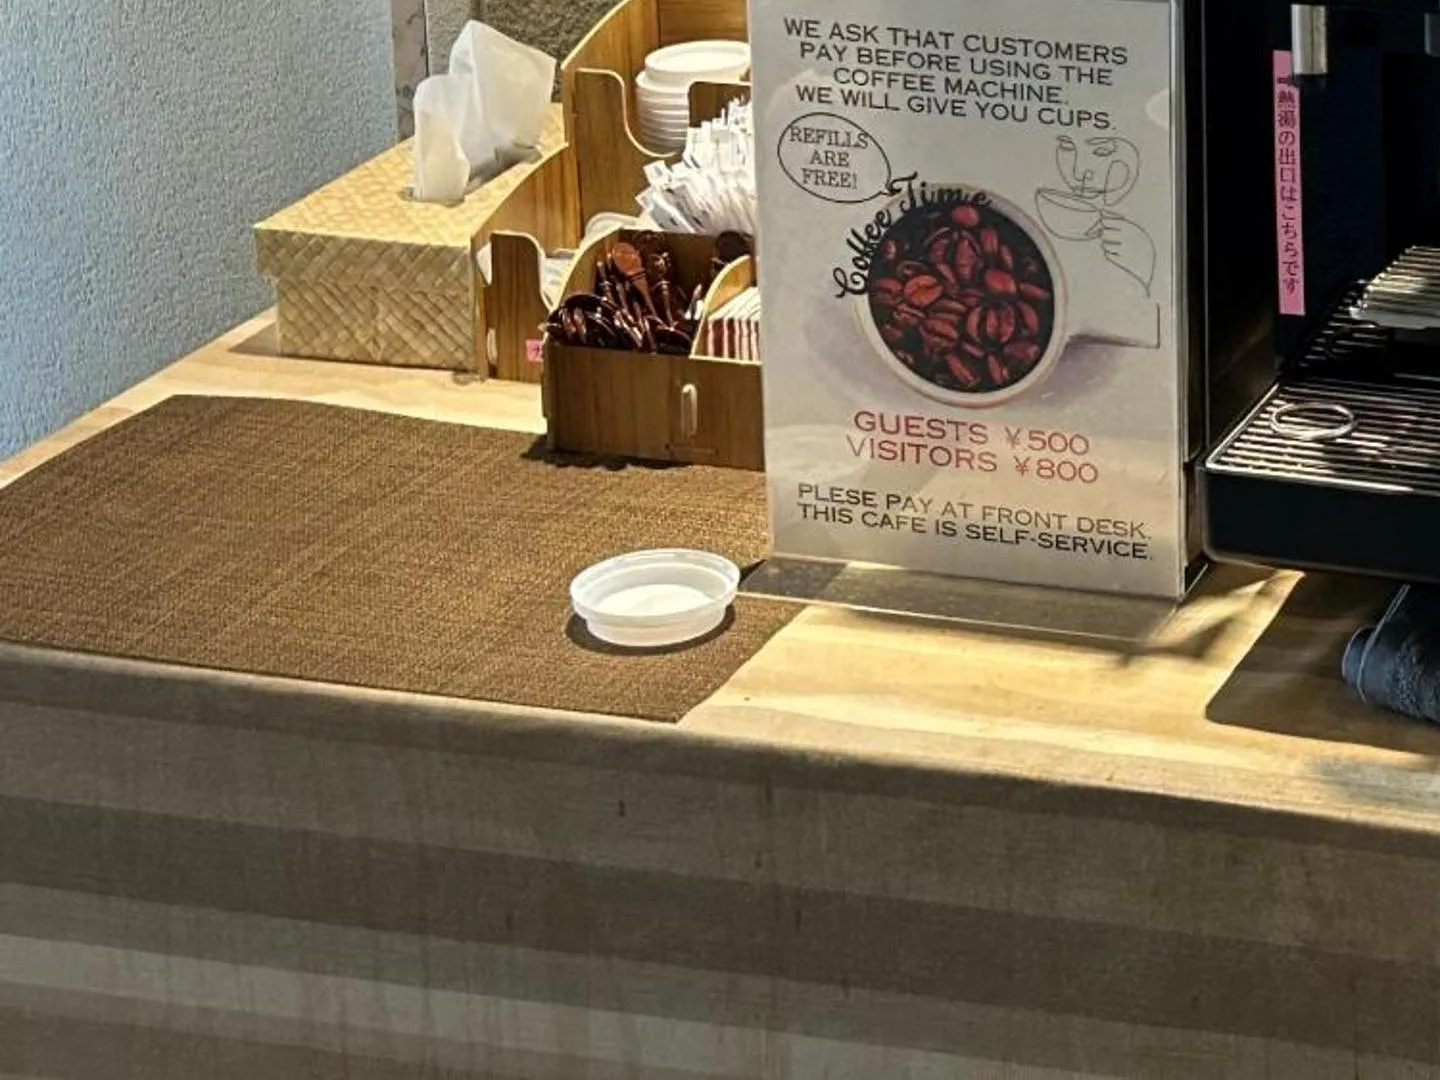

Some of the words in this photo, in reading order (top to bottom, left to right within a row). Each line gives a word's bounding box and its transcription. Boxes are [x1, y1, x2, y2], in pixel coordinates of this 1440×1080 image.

[784, 17, 821, 38] WE
[829, 22, 879, 44] ASK
[887, 27, 954, 50] THAT
[963, 34, 1128, 65] CUSTOMERS
[800, 42, 847, 61] PAY
[857, 47, 960, 72] BEFORE
[971, 58, 1050, 80] USING
[1057, 65, 1113, 86] THE
[833, 67, 936, 92] COFFEE
[944, 77, 1069, 104] MACHINE.
[796, 85, 832, 104] WE
[840, 90, 900, 111] WILL
[907, 96, 966, 117] GIVE
[975, 101, 1028, 123] YOU
[1038, 108, 1116, 130] CUPS.
[789, 126, 868, 149] REFILLS
[810, 150, 849, 167] ARE
[801, 168, 857, 189] FREE!
[832, 209, 892, 298] Coffee
[888, 171, 992, 213] Time
[854, 411, 988, 445] GUESTS
[1005, 425, 1089, 456] ¥500
[846, 435, 997, 473] VISITORS
[1014, 456, 1098, 483] ¥800
[797, 502, 853, 524] THIS
[862, 511, 927, 533] CAFE
[936, 518, 957, 537] IS
[965, 523, 1152, 561] SELF-SERVICE.
[798, 483, 878, 508] PLESE
[886, 493, 932, 513] PAY
[941, 501, 974, 519] AT
[982, 506, 1067, 531] FRONT
[1077, 517, 1152, 539] DESK.
